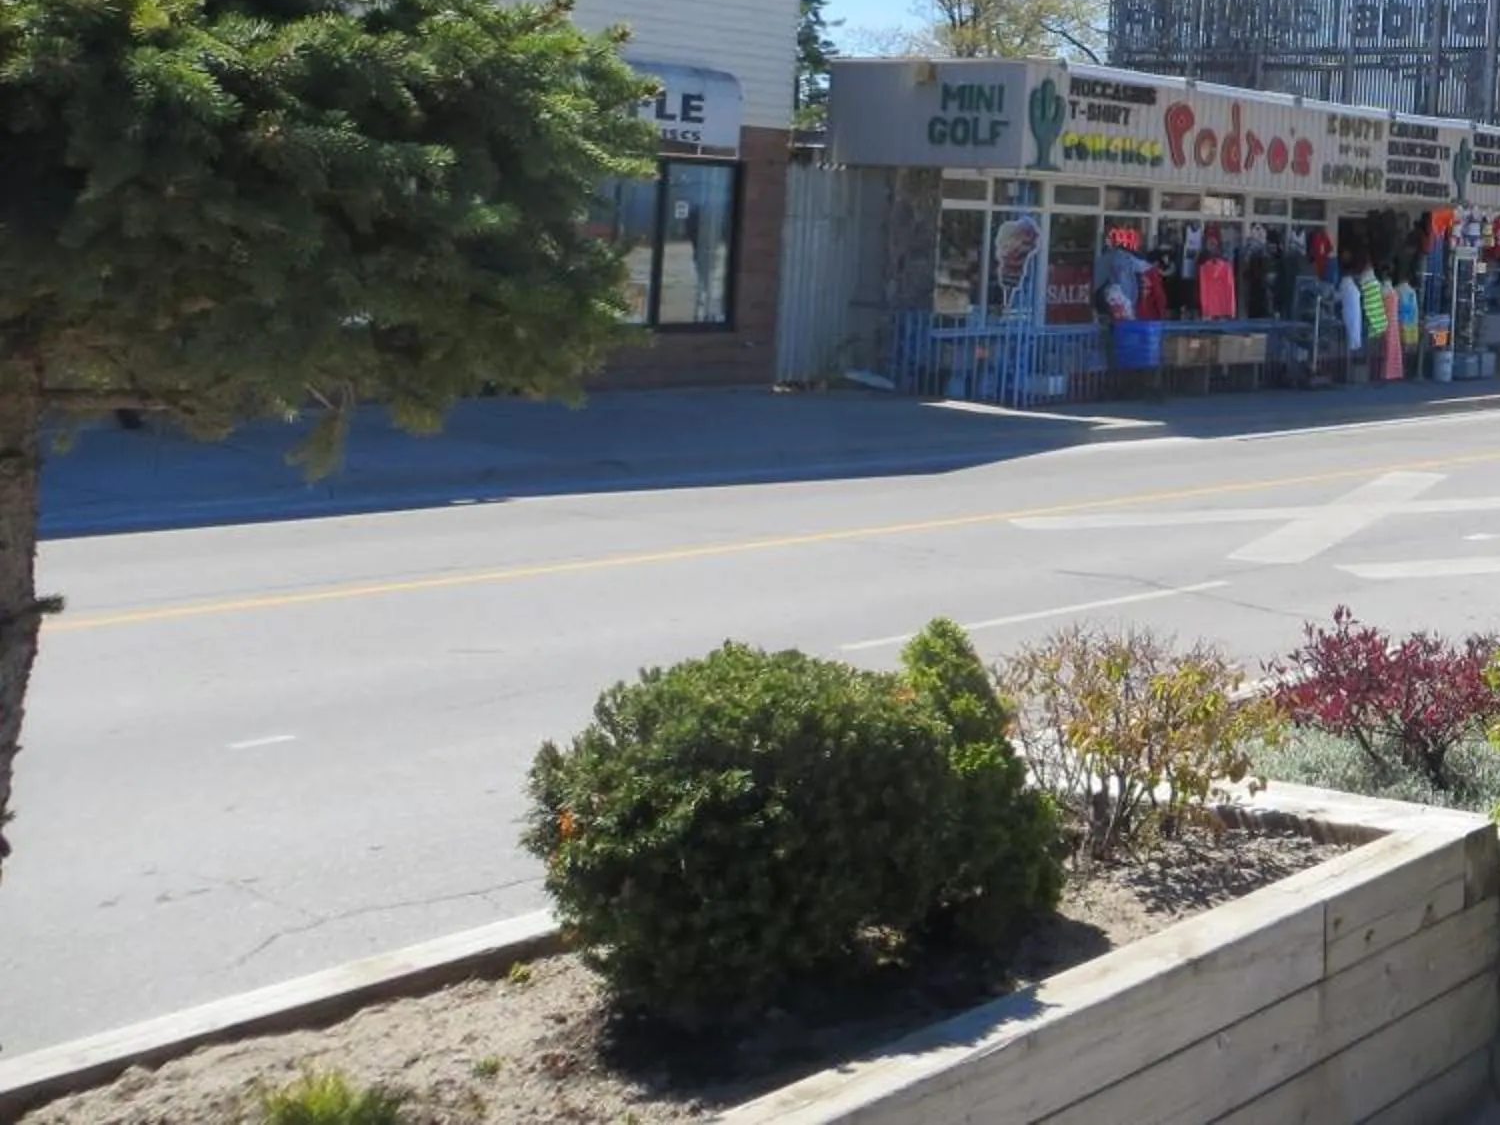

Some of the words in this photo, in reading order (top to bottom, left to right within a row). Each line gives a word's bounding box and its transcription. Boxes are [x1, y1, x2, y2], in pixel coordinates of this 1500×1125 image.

[941, 82, 1006, 113] MINI
[1068, 99, 1131, 126] T-SHIRT
[927, 115, 1010, 146] GOLF
[1047, 283, 1090, 305] SALE
